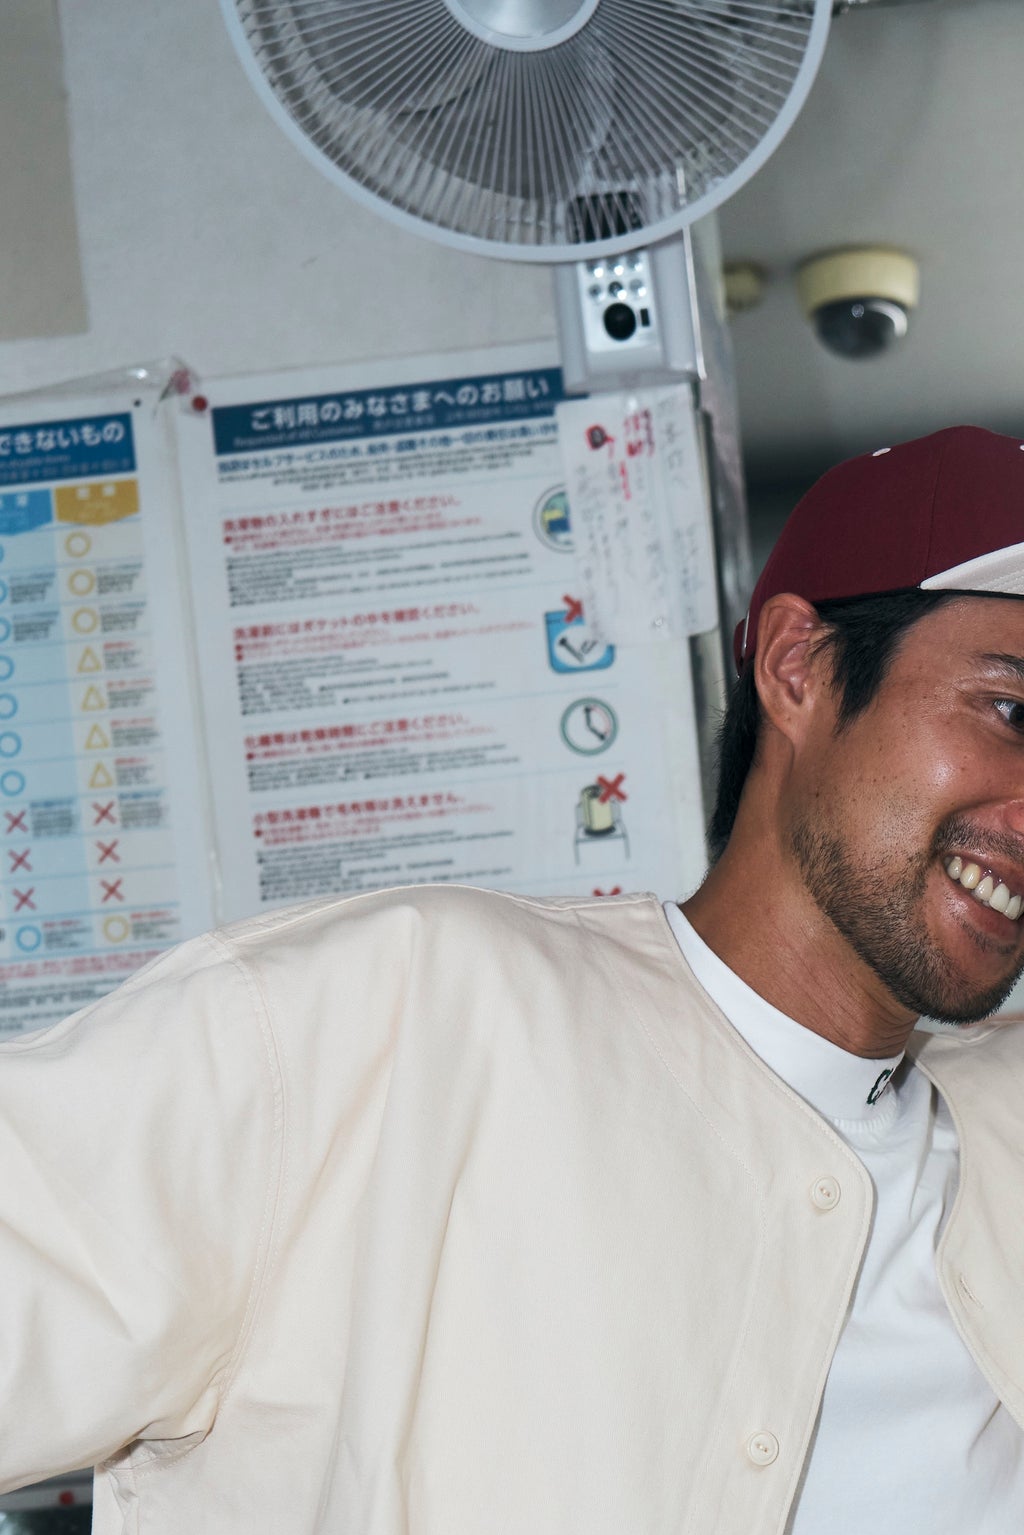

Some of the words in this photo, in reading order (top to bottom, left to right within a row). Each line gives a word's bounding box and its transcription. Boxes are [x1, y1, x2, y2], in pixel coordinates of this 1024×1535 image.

[251, 377, 549, 431] ご利用のみなさまへのお願い
